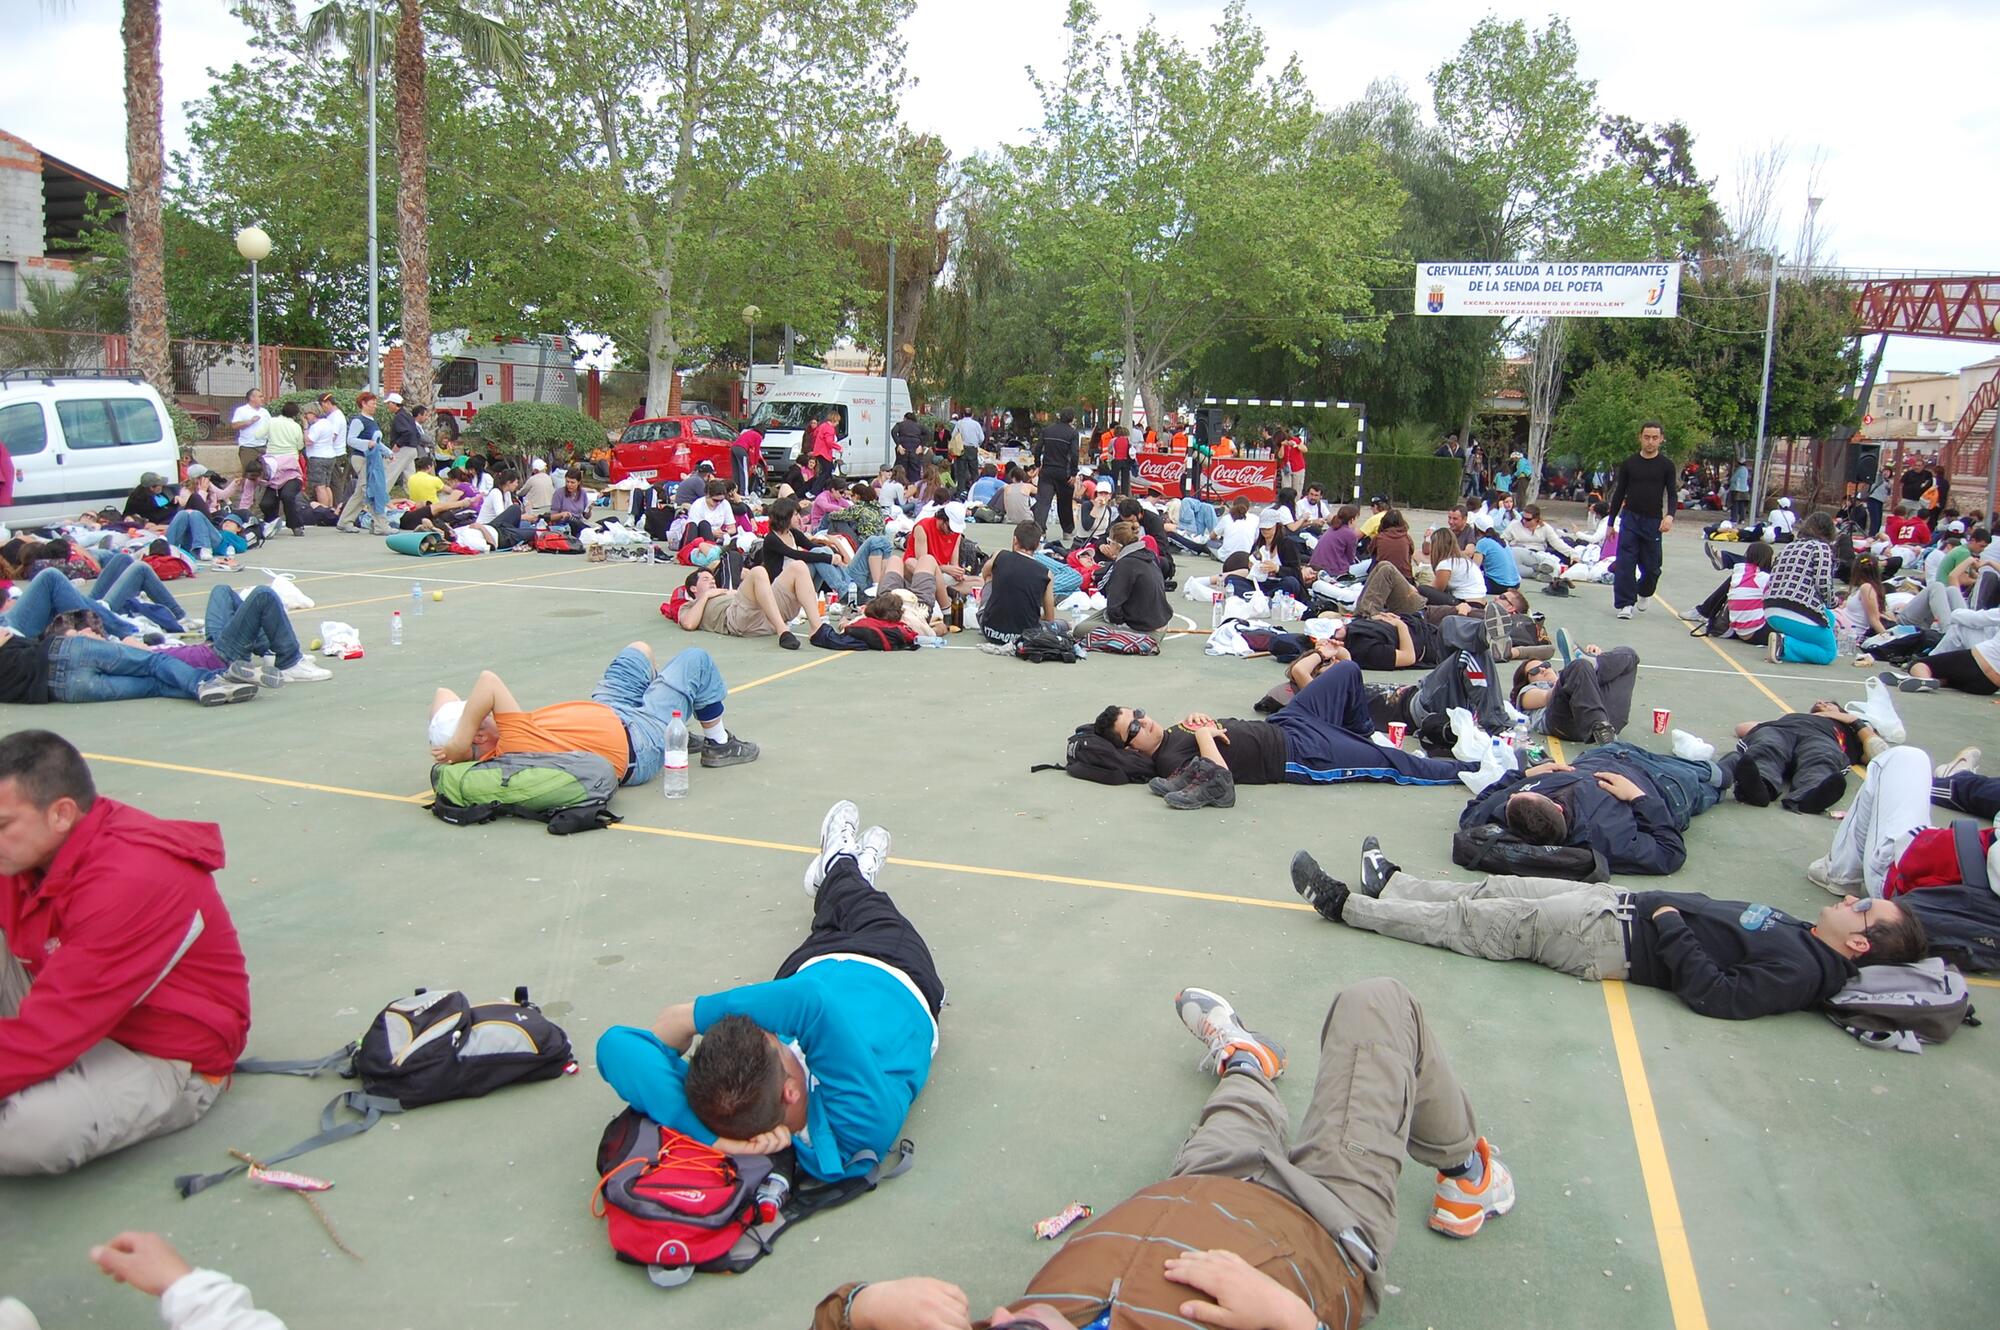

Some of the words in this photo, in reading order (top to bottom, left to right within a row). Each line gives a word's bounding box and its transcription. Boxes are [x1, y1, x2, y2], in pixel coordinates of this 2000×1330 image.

[1427, 265, 1491, 278] CREVILLENT,
[1495, 265, 1539, 276] SALUDA
[1546, 265, 1555, 276] A
[1558, 265, 1578, 276] LOS
[1582, 265, 1668, 276] PARTICIPANTES
[1469, 281, 1484, 292] DE
[1486, 281, 1499, 292] LA
[1503, 281, 1540, 292] SENDA
[1543, 281, 1563, 292] DEL
[1567, 281, 1603, 292] POETA
[1898, 526, 1915, 539] 23
